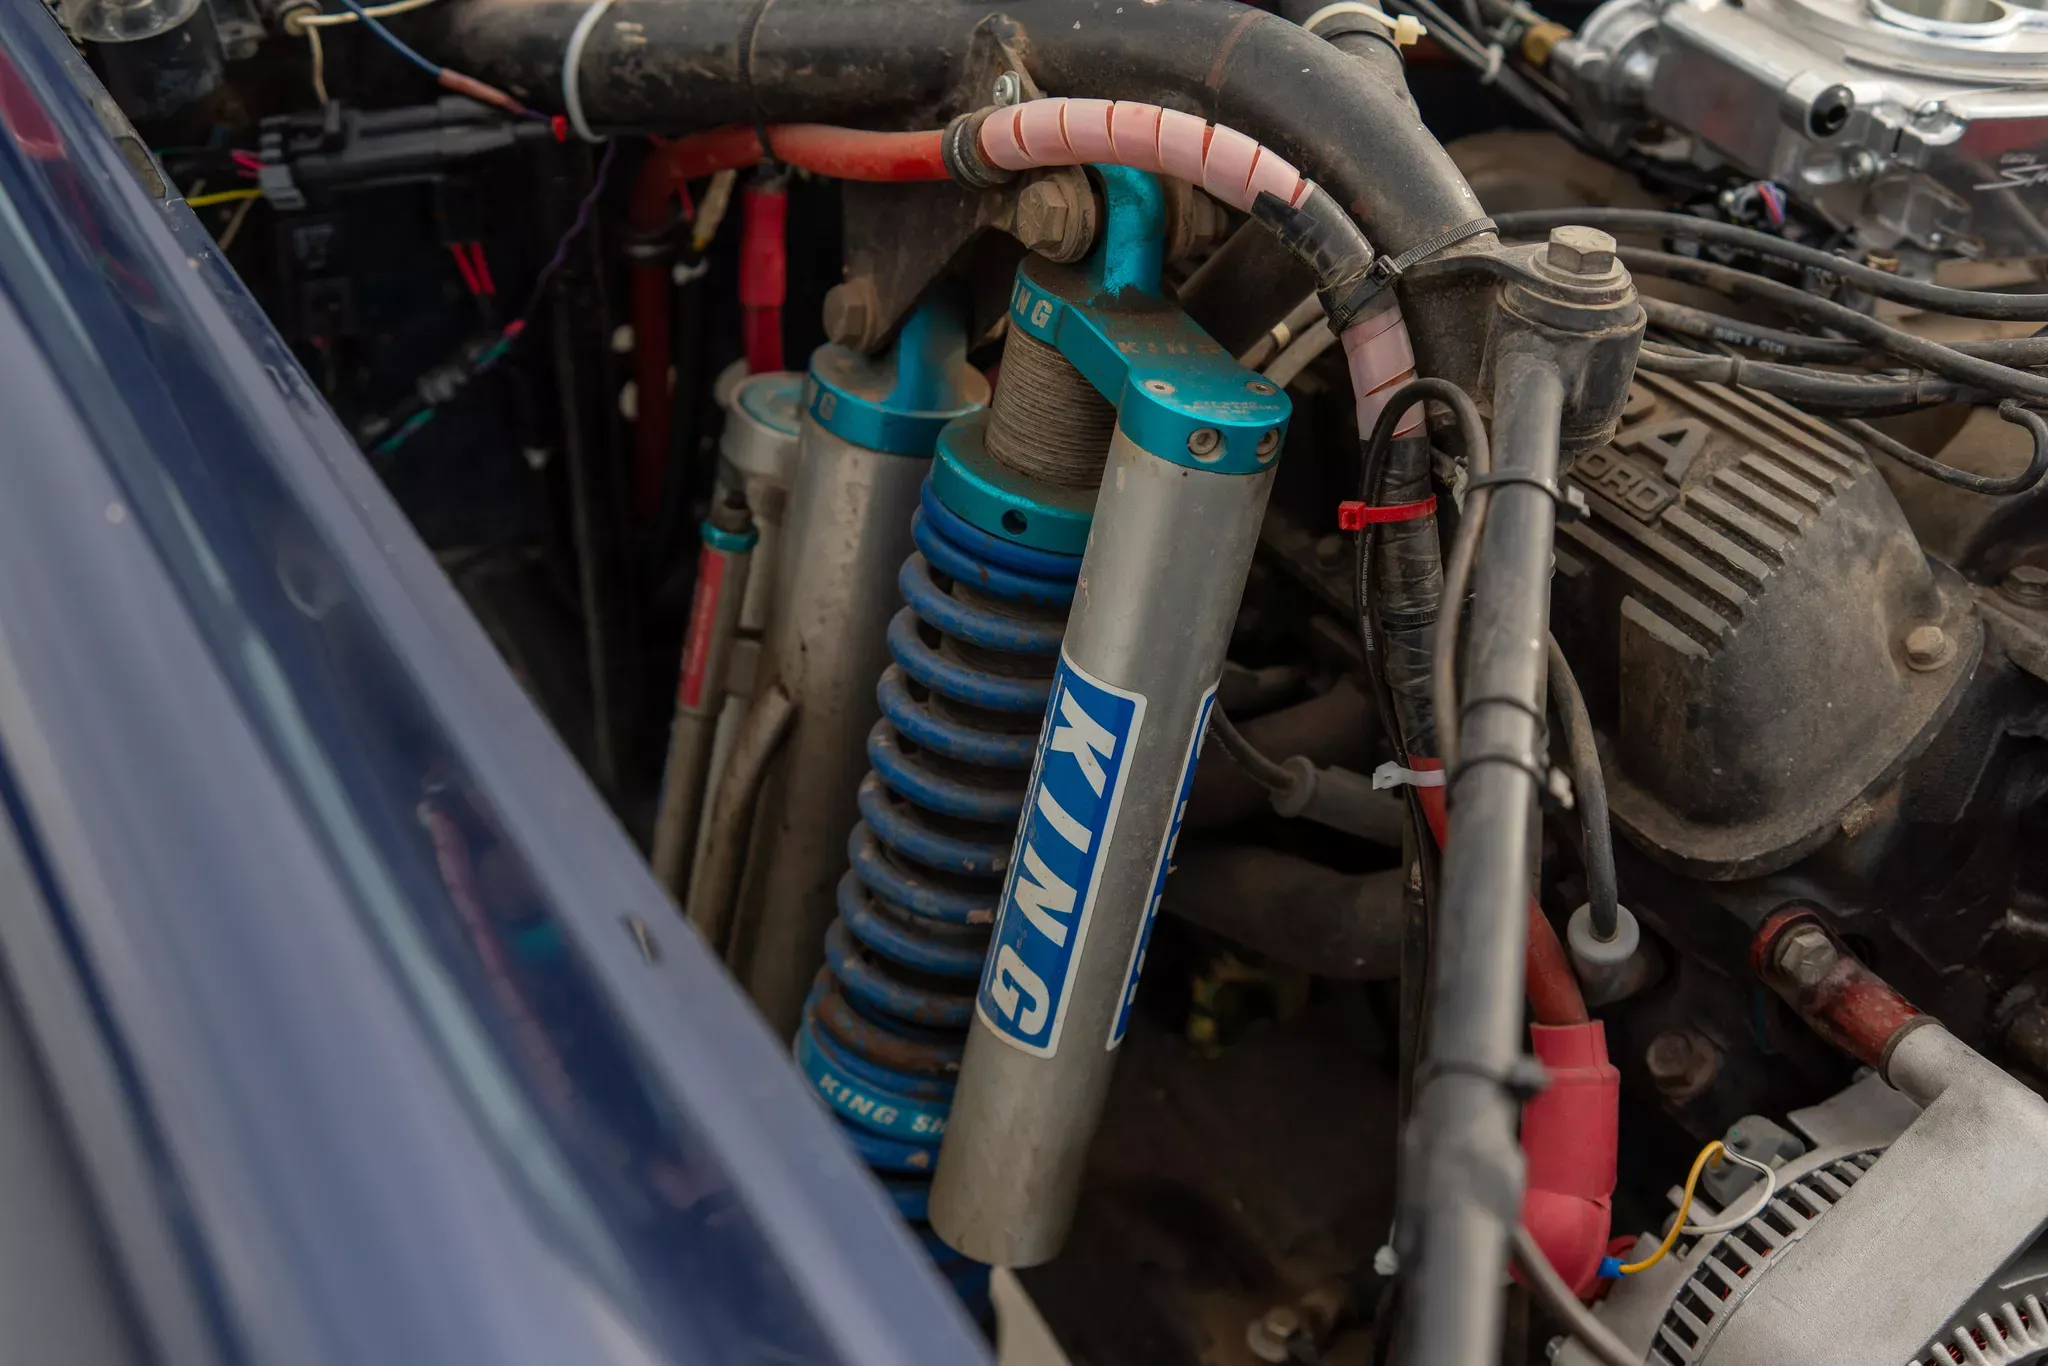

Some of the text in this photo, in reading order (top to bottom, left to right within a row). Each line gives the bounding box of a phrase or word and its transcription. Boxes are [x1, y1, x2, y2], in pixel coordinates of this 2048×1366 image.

[1011, 279, 1053, 329] ING
[1574, 451, 1669, 512] ORD
[990, 687, 1117, 1036] KING
[819, 1073, 898, 1125] KING
